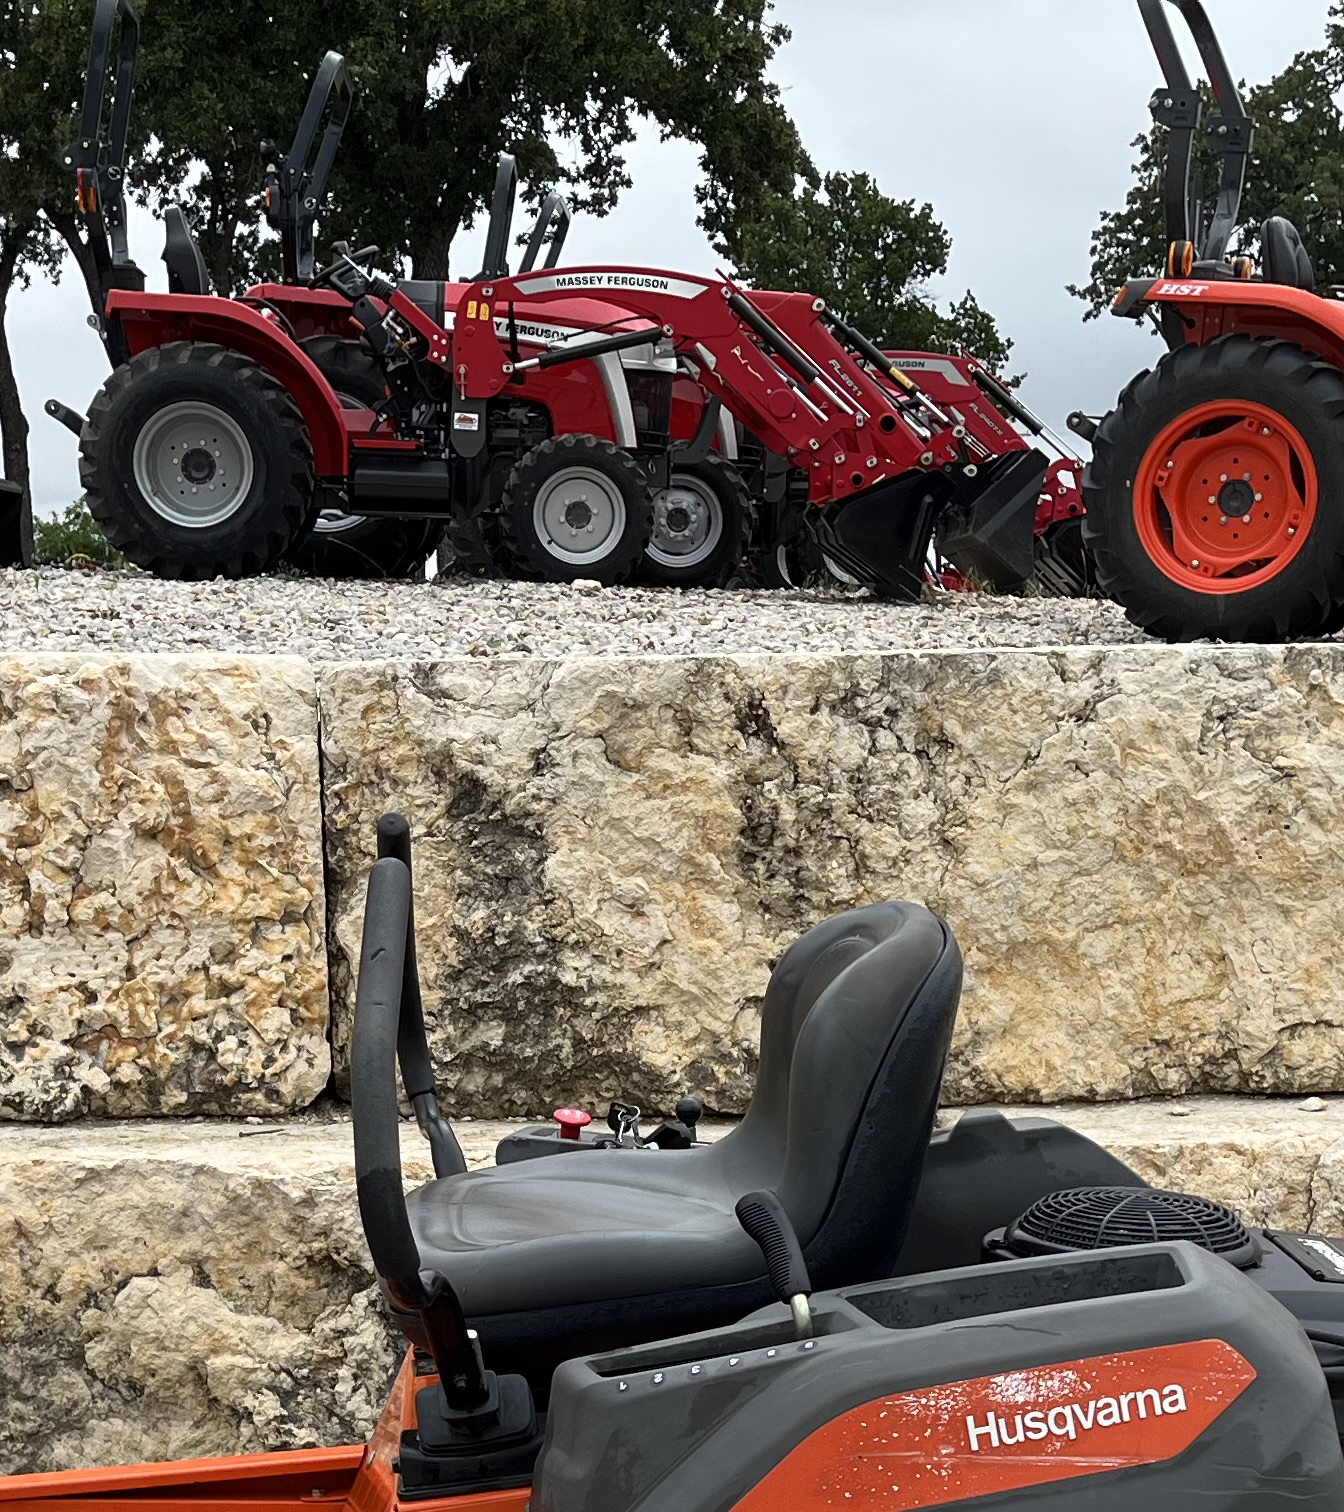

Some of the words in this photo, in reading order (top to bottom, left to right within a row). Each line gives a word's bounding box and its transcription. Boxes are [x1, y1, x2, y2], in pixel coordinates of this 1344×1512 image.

[556, 276, 604, 287] MASSEY
[607, 275, 669, 290] FERGUSON
[1156, 283, 1210, 297] HST
[966, 1384, 1187, 1451] Husqvarna
